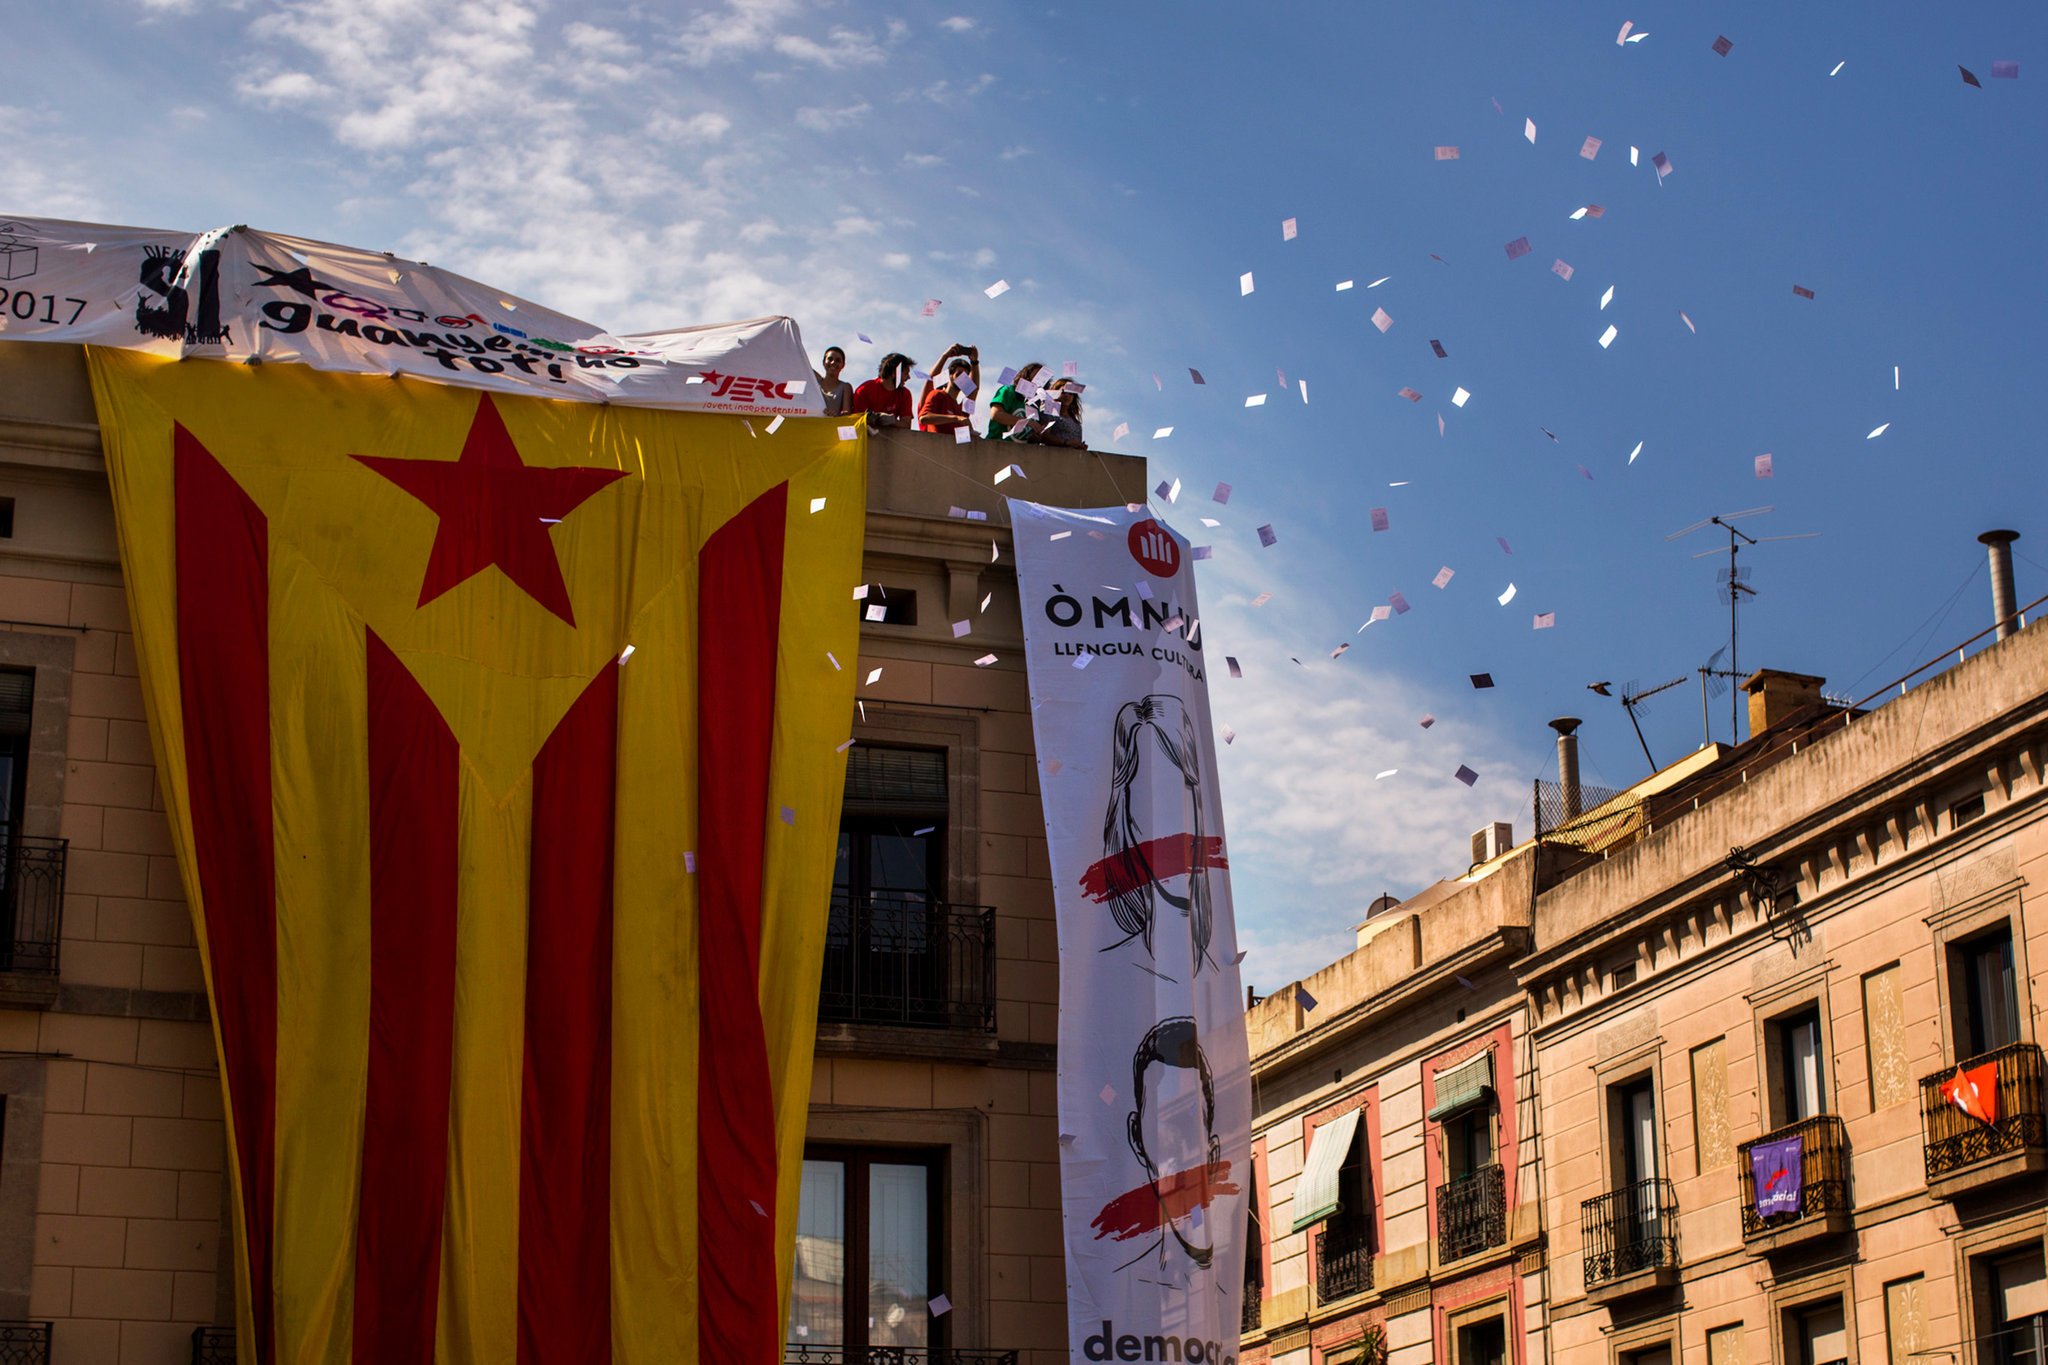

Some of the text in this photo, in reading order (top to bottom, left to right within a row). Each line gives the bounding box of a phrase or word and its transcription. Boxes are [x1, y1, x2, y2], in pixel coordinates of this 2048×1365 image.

[143, 245, 187, 259] DIEM
[711, 375, 794, 403] JERC
[702, 401, 807, 415] jovent independentista
[1054, 642, 1204, 683] LLENGUA CULTURA
